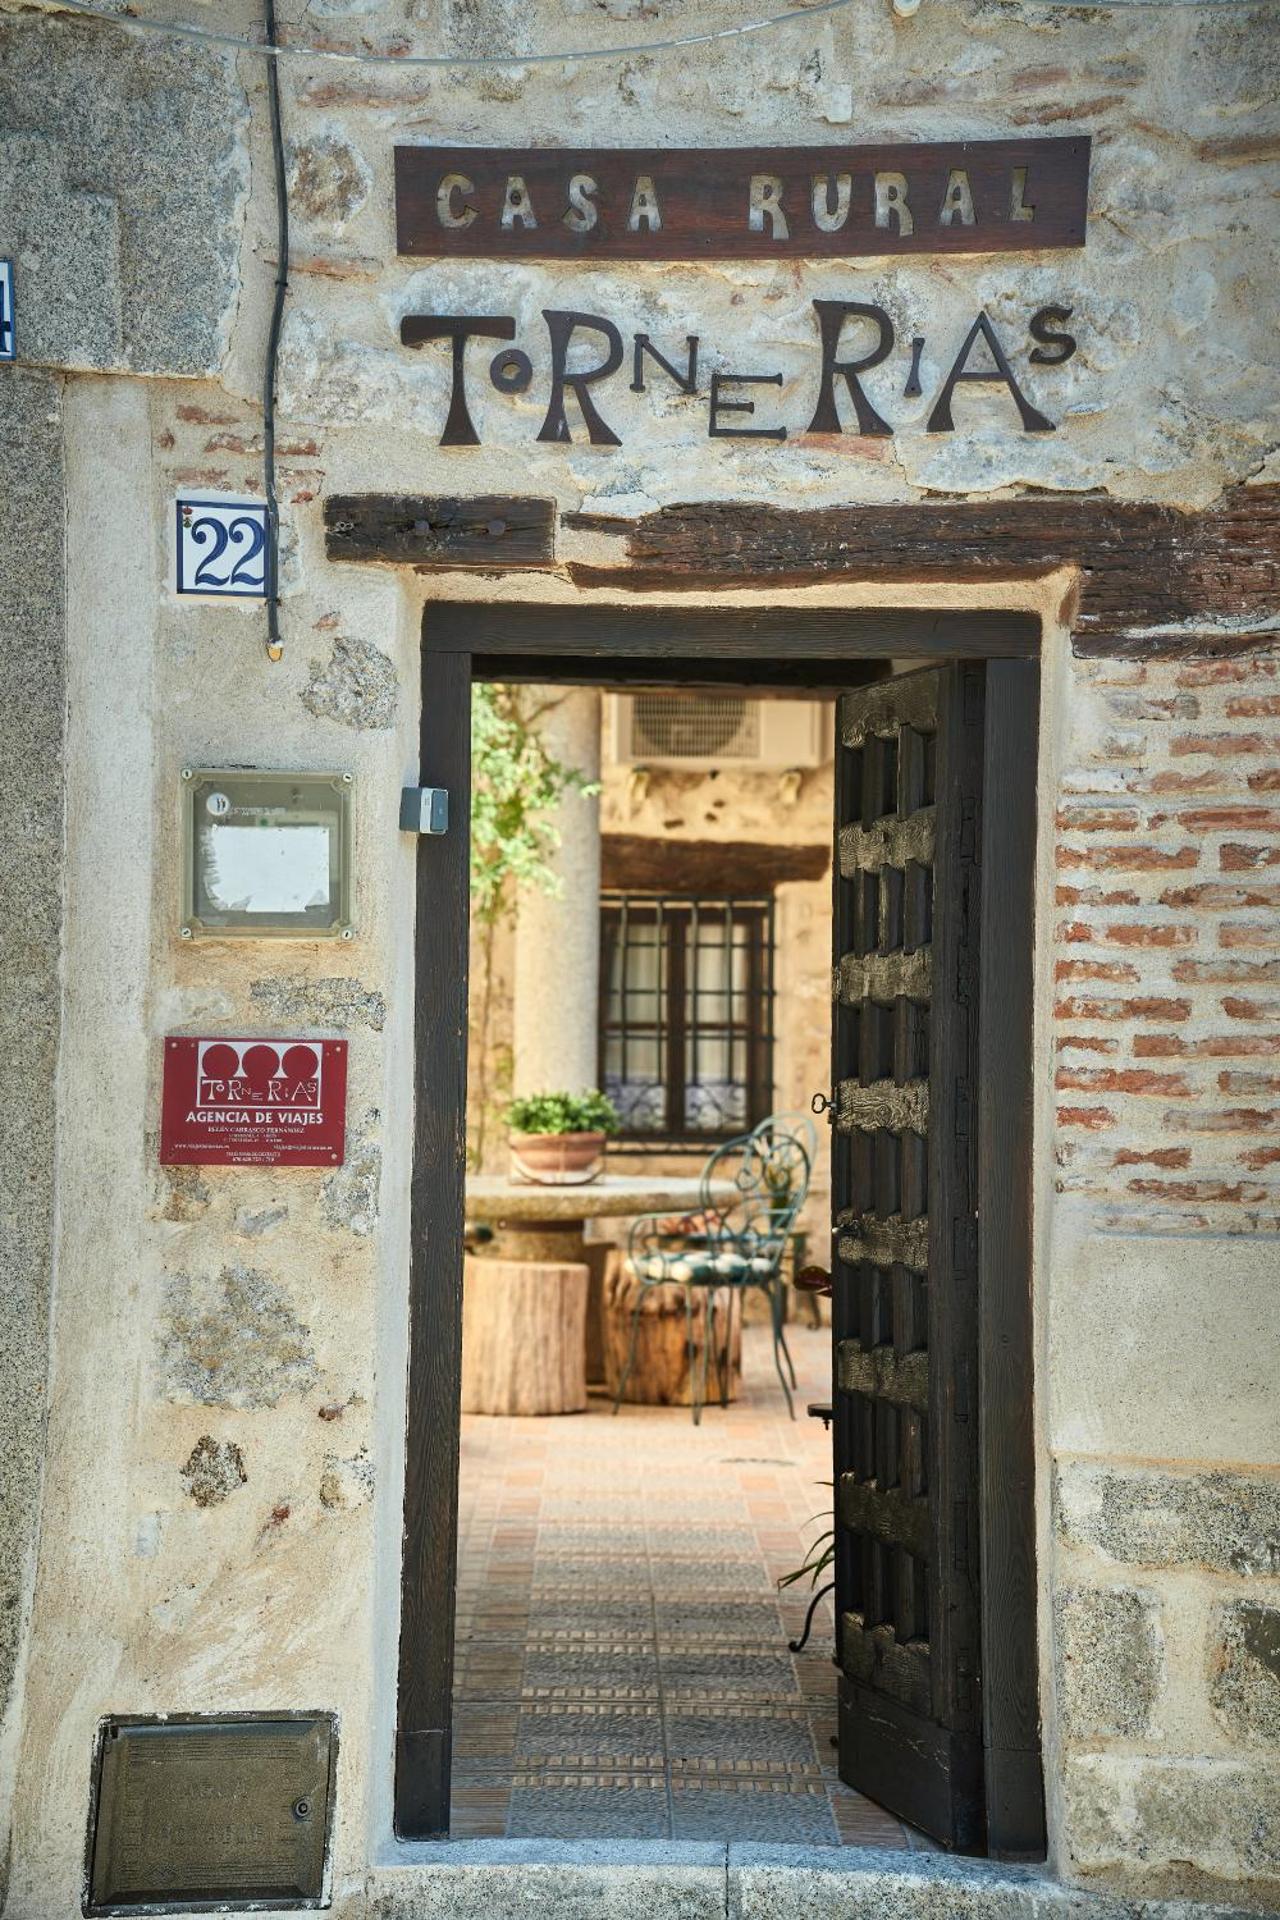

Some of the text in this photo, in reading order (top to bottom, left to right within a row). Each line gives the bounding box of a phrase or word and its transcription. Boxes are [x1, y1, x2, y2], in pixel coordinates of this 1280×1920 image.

[436, 165, 1037, 240] CASA RURAL
[400, 300, 1078, 447] TORNERIAS
[191, 516, 266, 587] 22
[185, 1111, 324, 1125] AGENCIA DE VIAJES
